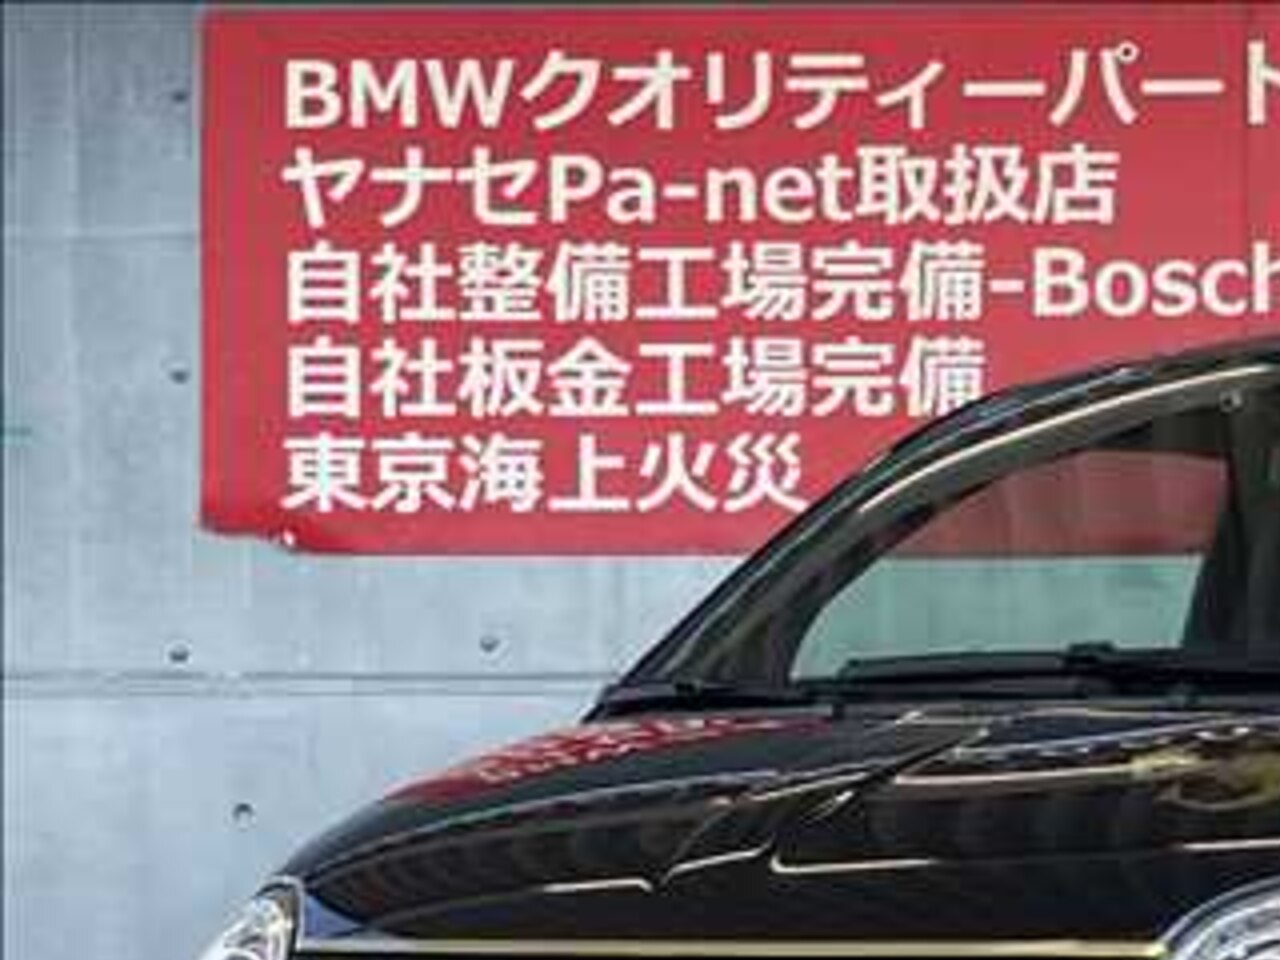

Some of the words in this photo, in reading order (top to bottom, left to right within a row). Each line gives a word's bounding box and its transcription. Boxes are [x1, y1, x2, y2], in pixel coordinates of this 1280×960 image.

[281, 143, 1119, 228] ヤナセPa-net取扱店
[285, 337, 986, 418] 自社板金工場完備
[281, 433, 808, 513] 東京海上火災
